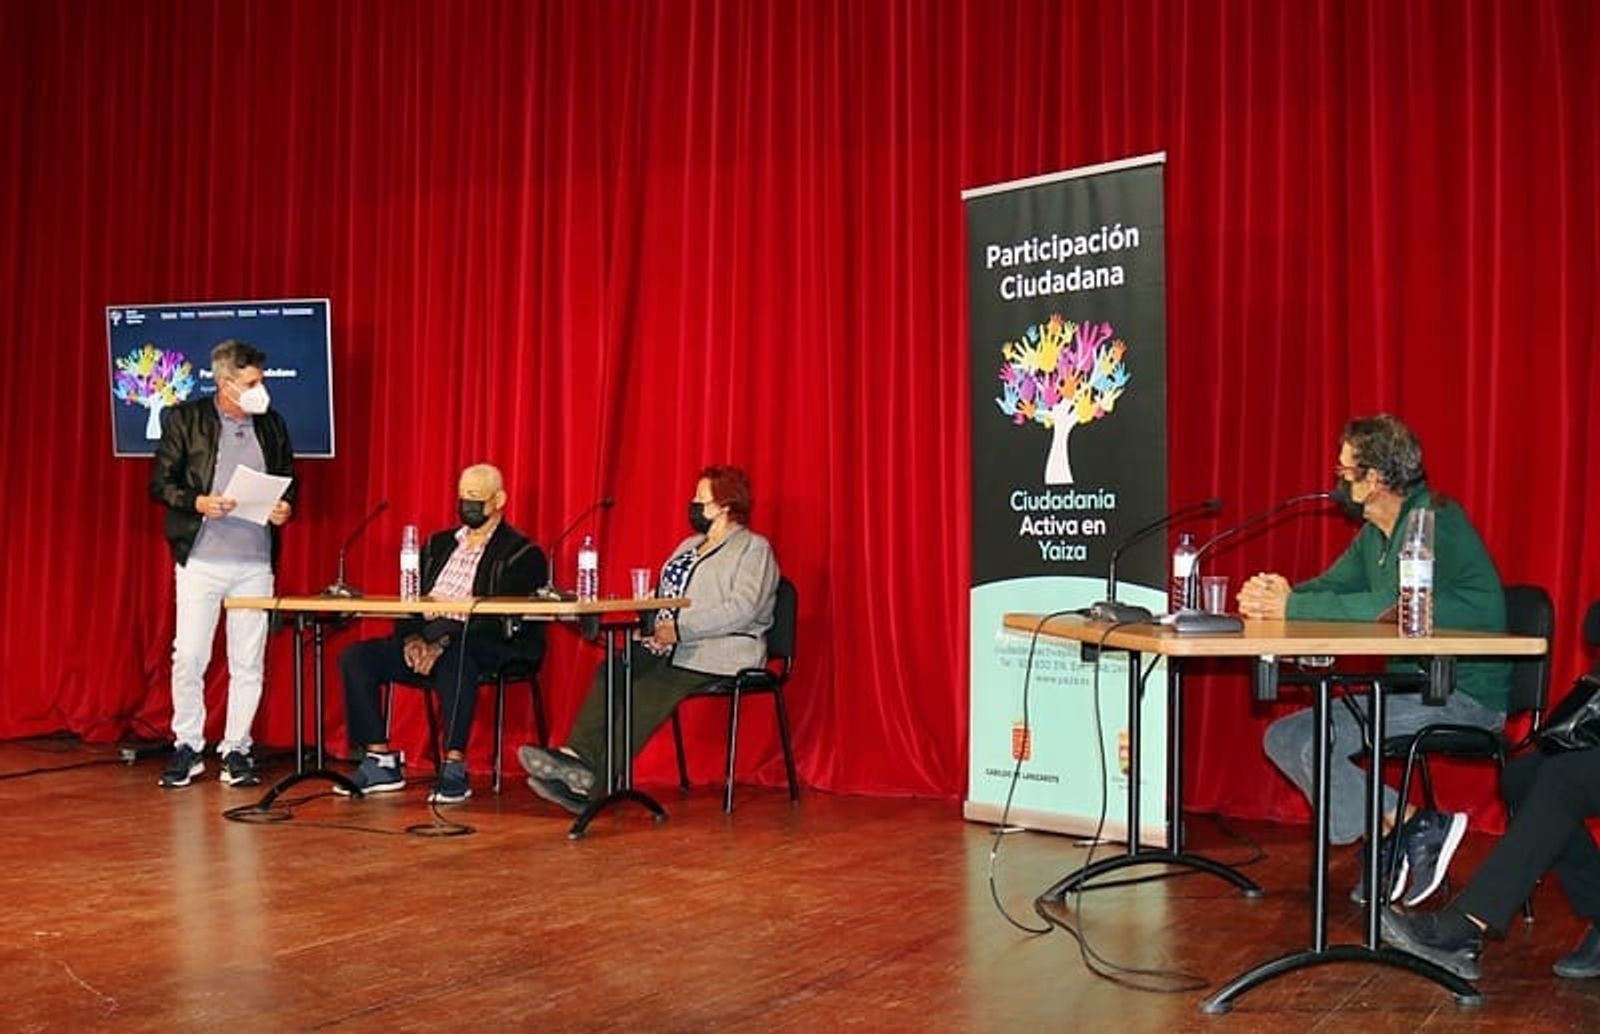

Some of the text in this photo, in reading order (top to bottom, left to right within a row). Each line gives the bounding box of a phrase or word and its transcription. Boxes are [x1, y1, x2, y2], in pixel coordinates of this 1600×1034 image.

[986, 223, 1139, 269] Participación
[1000, 265, 1124, 299] Ciudadana
[1020, 515, 1106, 535] Activa en
[1038, 540, 1087, 560] Yaiza
